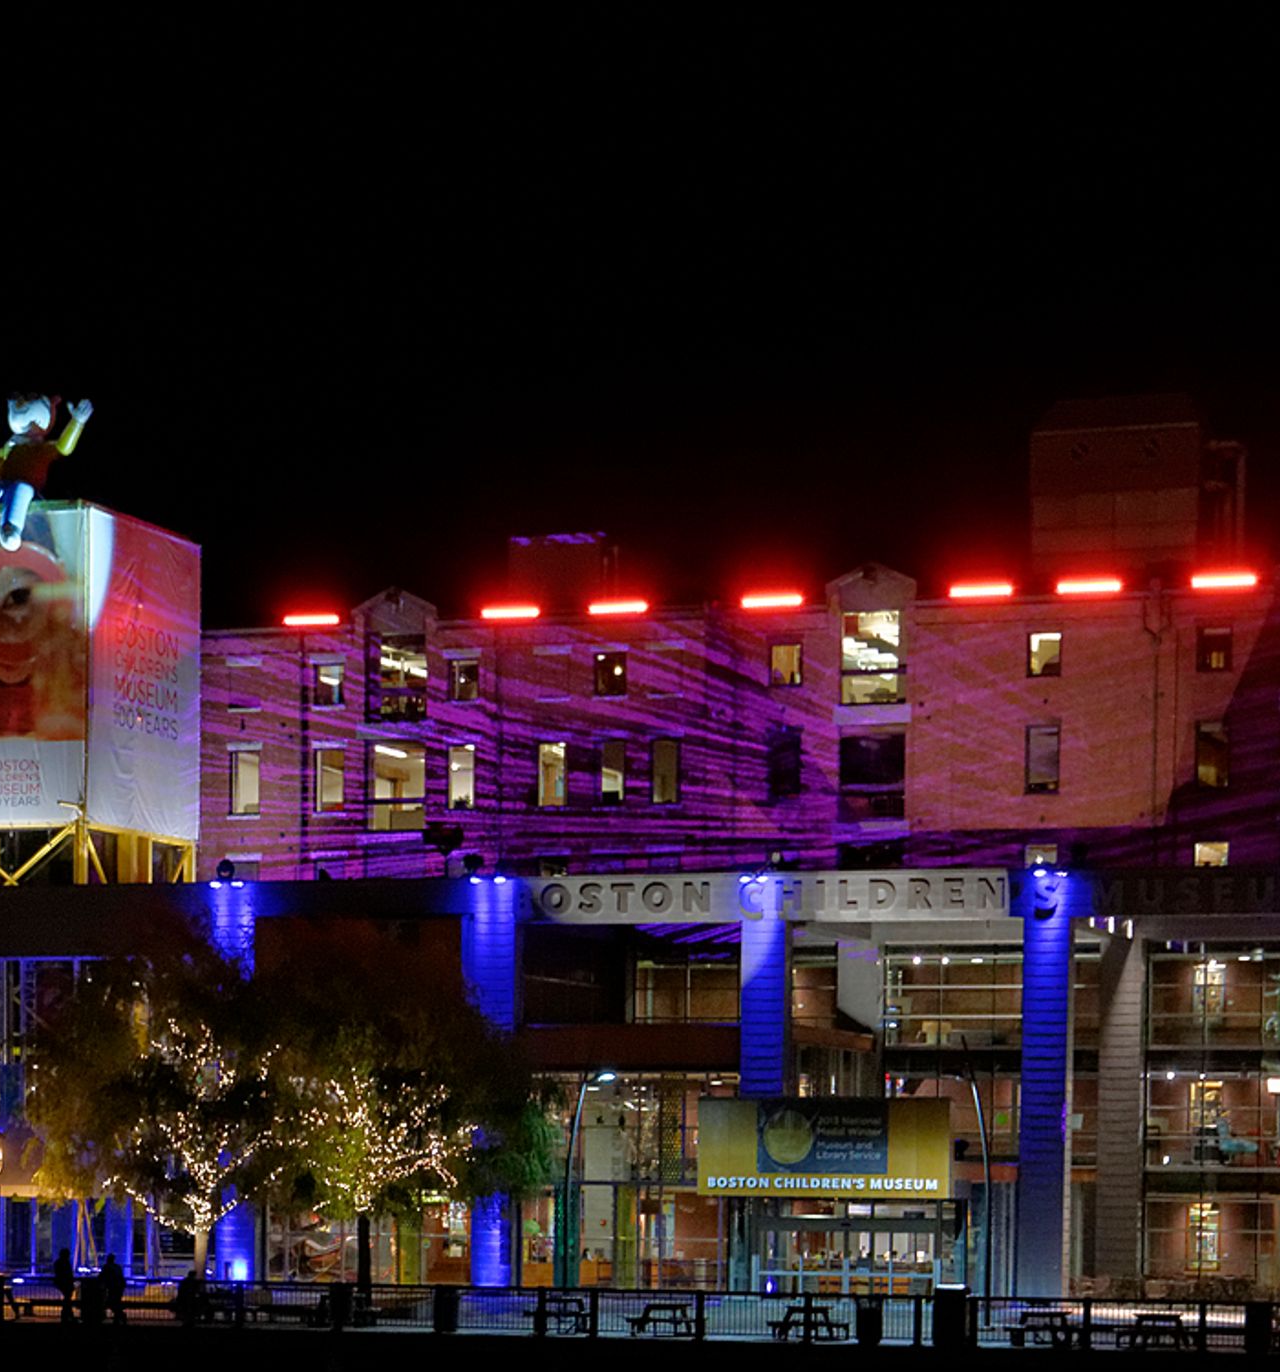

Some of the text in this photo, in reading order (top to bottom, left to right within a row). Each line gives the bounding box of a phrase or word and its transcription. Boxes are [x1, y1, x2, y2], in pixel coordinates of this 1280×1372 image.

[114, 618, 179, 660] BOSTON
[114, 674, 179, 714] MUSEUM
[2, 796, 41, 807] YEARS
[707, 1176, 939, 1191] BOSTON CHILDREN'S MUSEUM
